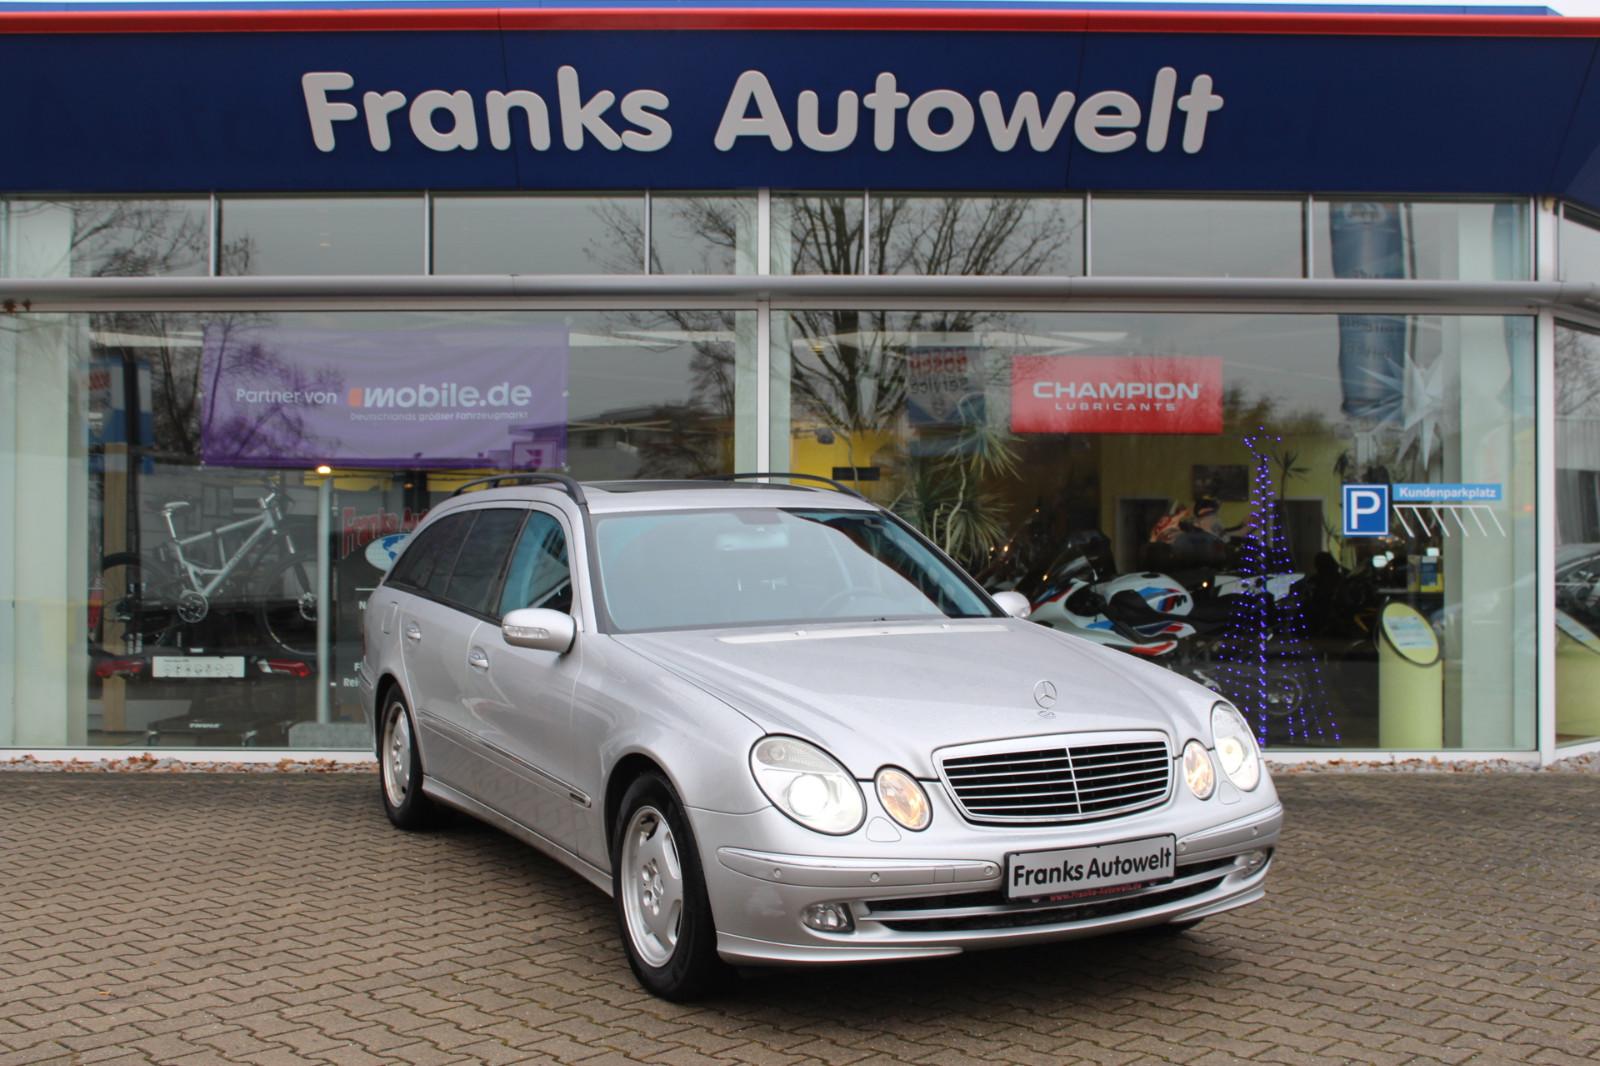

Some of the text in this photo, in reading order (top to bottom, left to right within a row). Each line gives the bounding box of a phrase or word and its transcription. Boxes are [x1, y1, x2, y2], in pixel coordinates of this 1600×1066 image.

[302, 65, 1225, 154] Franks Autowelt
[236, 388, 337, 404] Partner von
[363, 382, 532, 408] mobile.de
[1032, 381, 1200, 400] CHAMPION
[1055, 402, 1178, 412] LUBRICANTS
[1399, 487, 1497, 499] Kundenparkplatz
[1351, 490, 1382, 530] P
[1013, 847, 1172, 887] Franks Autowelt
